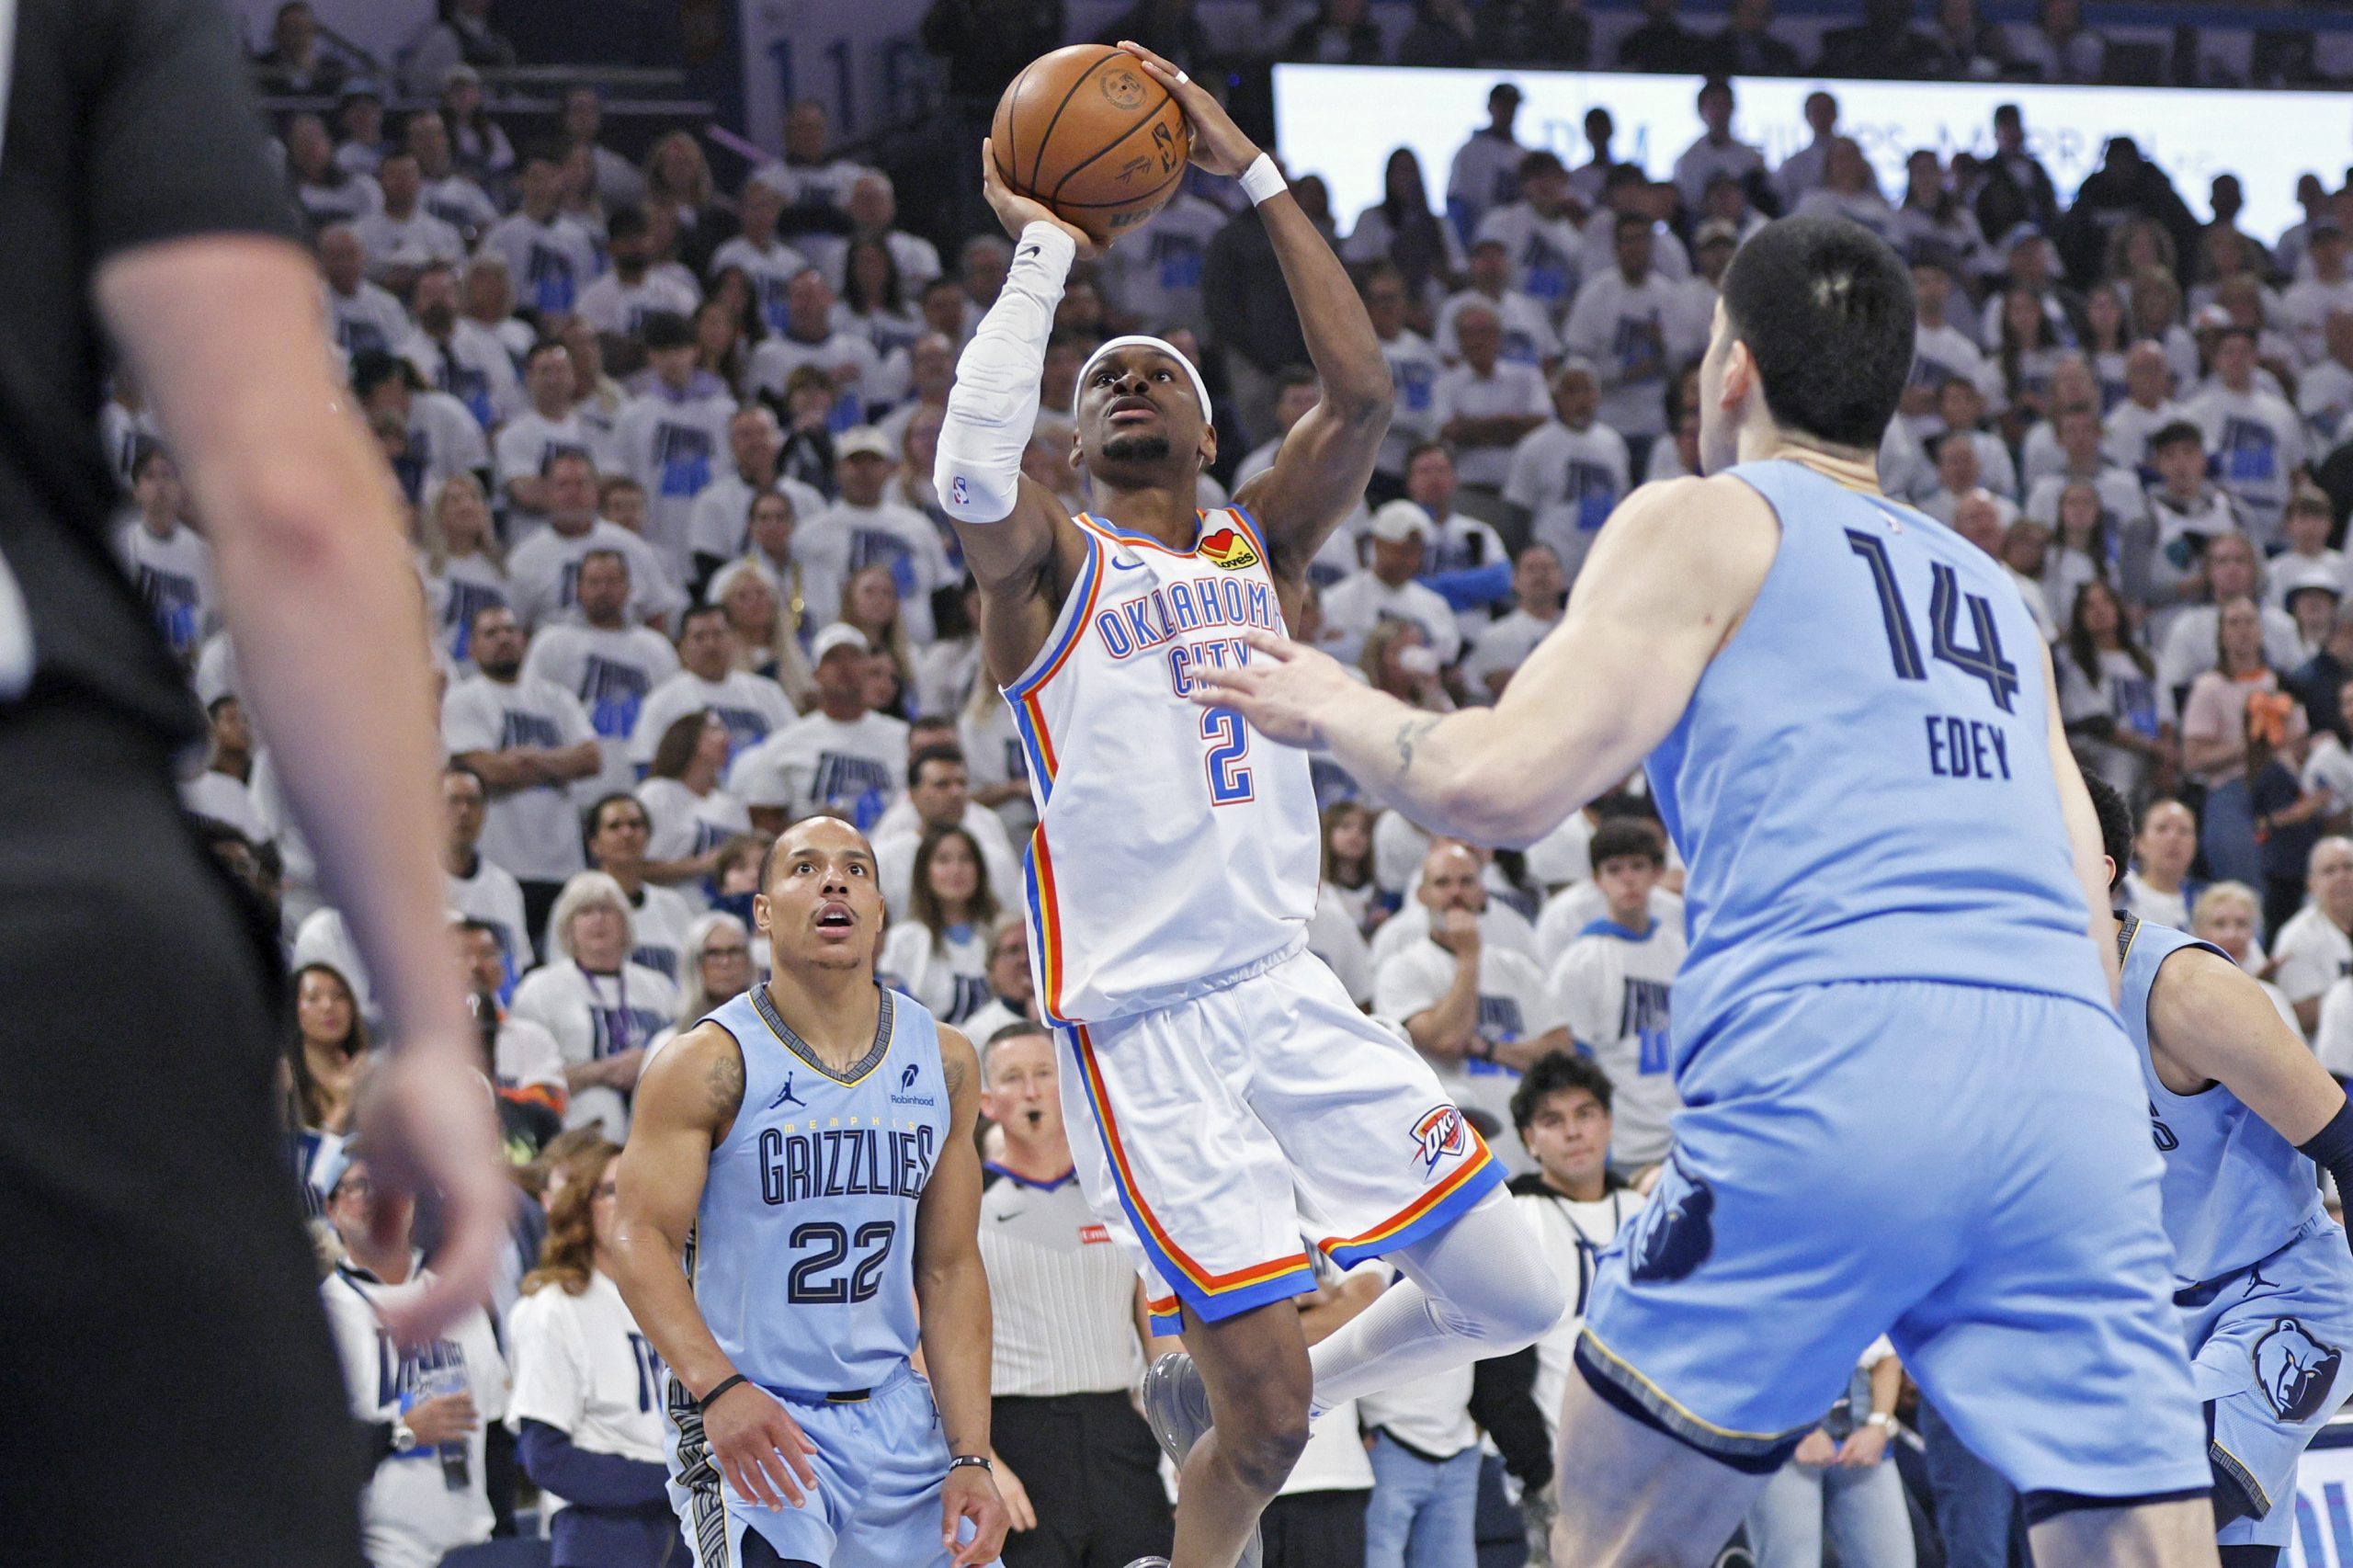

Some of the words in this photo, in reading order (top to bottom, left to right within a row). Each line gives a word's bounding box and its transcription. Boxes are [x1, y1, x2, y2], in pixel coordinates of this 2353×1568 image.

[1843, 527, 2020, 716] 14
[1199, 704, 1255, 807] 2
[1926, 715, 2012, 781] EDEY
[784, 1116, 916, 1133] MEMPHIS
[891, 1095, 934, 1106] Robinhood
[1424, 1109, 1456, 1165] OKC
[759, 1124, 933, 1206] GRIZZLIES
[788, 1221, 896, 1304] 22
